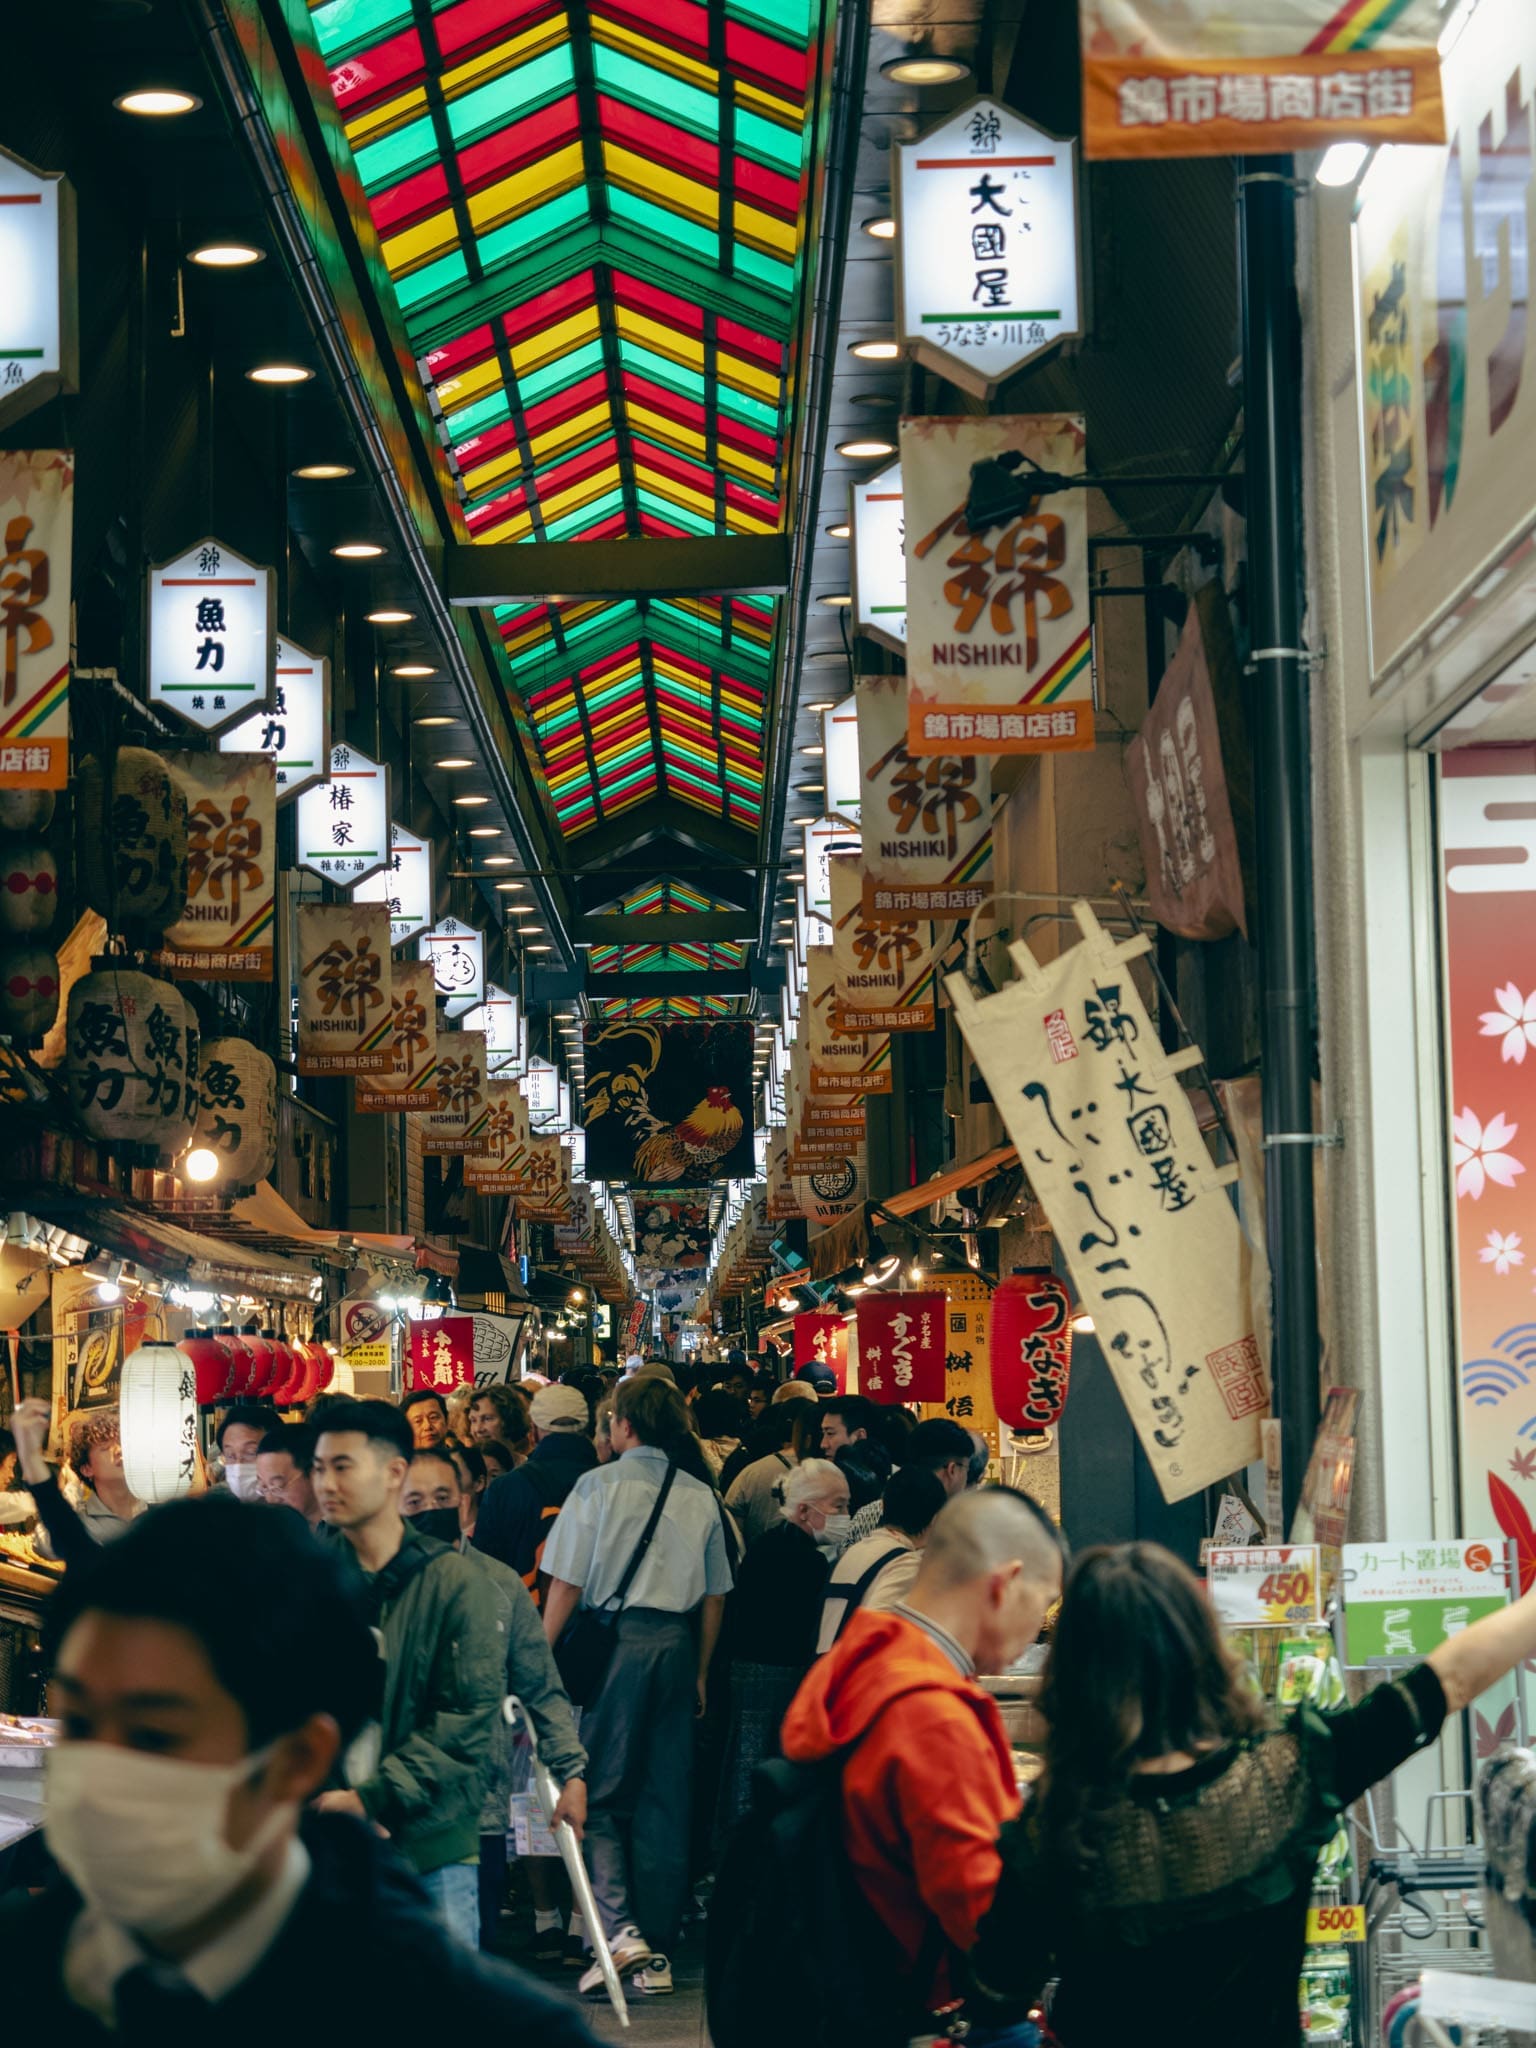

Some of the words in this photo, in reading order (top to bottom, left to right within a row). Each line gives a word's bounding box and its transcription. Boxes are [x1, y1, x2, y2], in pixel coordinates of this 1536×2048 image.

[1118, 69, 1414, 126] 錦市場商店街
[965, 110, 1002, 152] 錦
[969, 173, 1013, 307] 大國屋
[937, 321, 1048, 347] うなぎ・川魚
[3, 361, 25, 385] 魚
[195, 546, 221, 576] 錦
[195, 598, 226, 672] 魚力
[932, 643, 1023, 666] NISHIKI
[262, 686, 287, 751] 魚力
[923, 711, 1076, 740] 錦市場商店街
[329, 784, 355, 847] 椿家
[880, 840, 946, 858] NISHIKI
[875, 889, 983, 910] 錦市場商店街
[184, 904, 229, 921] SHIKI
[160, 951, 262, 970] 錦市場商店街
[302, 937, 386, 1034] 錦
[847, 974, 896, 988] NISHIKI
[310, 1018, 358, 1033] NISHIKI
[844, 1010, 926, 1028] 錦市場商店街
[304, 1054, 384, 1069] 錦市場商店街
[821, 1044, 862, 1056] NISHIKI
[817, 1074, 885, 1088] 錦市場商店街
[201, 1060, 246, 1154] 魚力
[430, 1114, 464, 1124] NISHIKI
[920, 1312, 932, 1349] 京名産
[888, 1312, 917, 1387] すぐき
[1021, 1283, 1069, 1421] うなぎ
[1361, 1548, 1461, 1572] カート置場
[1258, 1572, 1311, 1605] 450
[1318, 1908, 1355, 1930] 500
